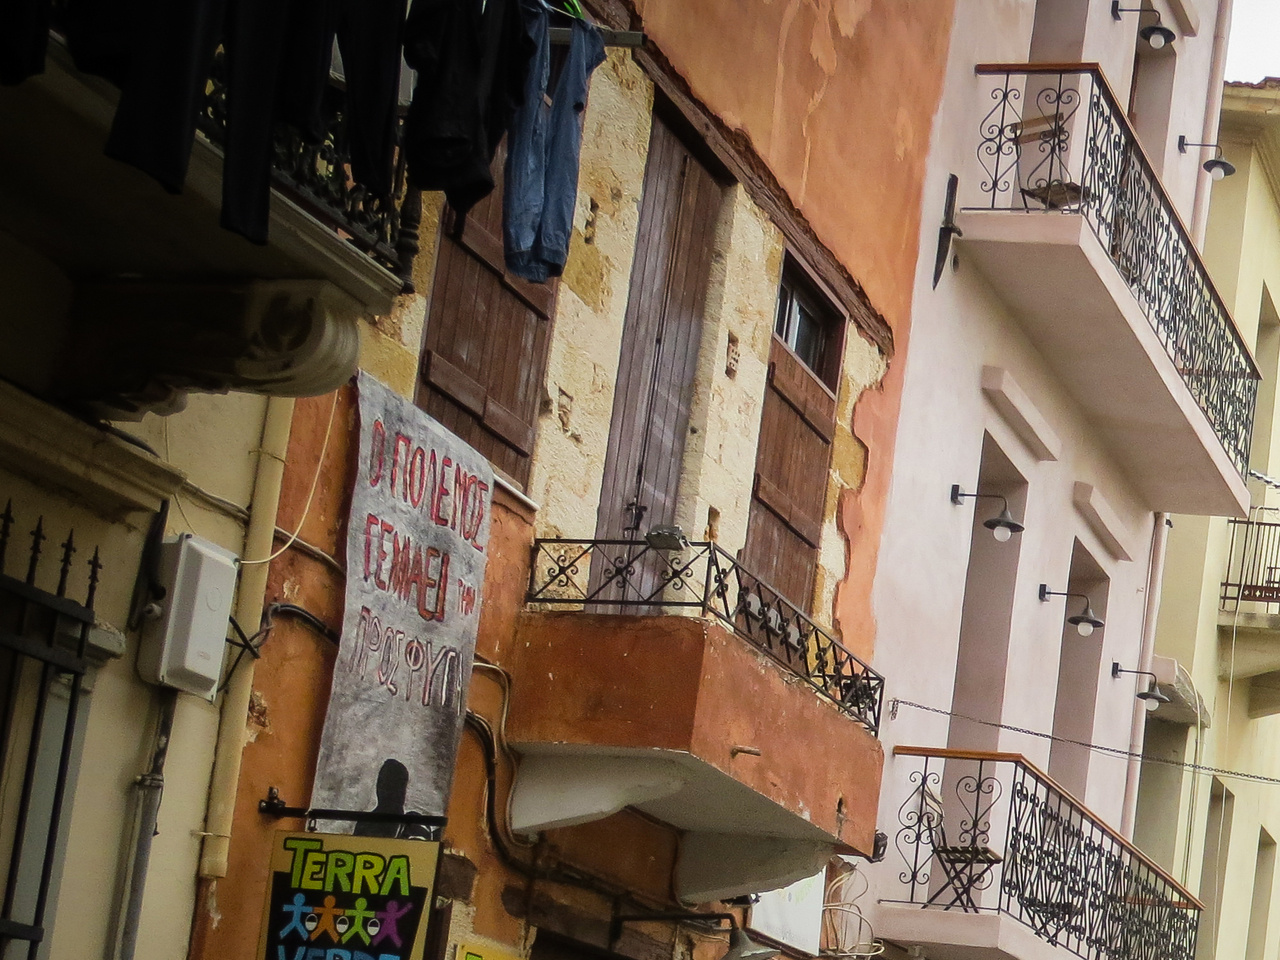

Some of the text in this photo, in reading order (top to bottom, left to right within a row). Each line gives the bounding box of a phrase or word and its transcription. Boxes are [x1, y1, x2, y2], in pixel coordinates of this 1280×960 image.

[369, 418, 489, 552] Ο ΠΟΛΕΜΟΣ
[284, 837, 410, 897] TERRA
